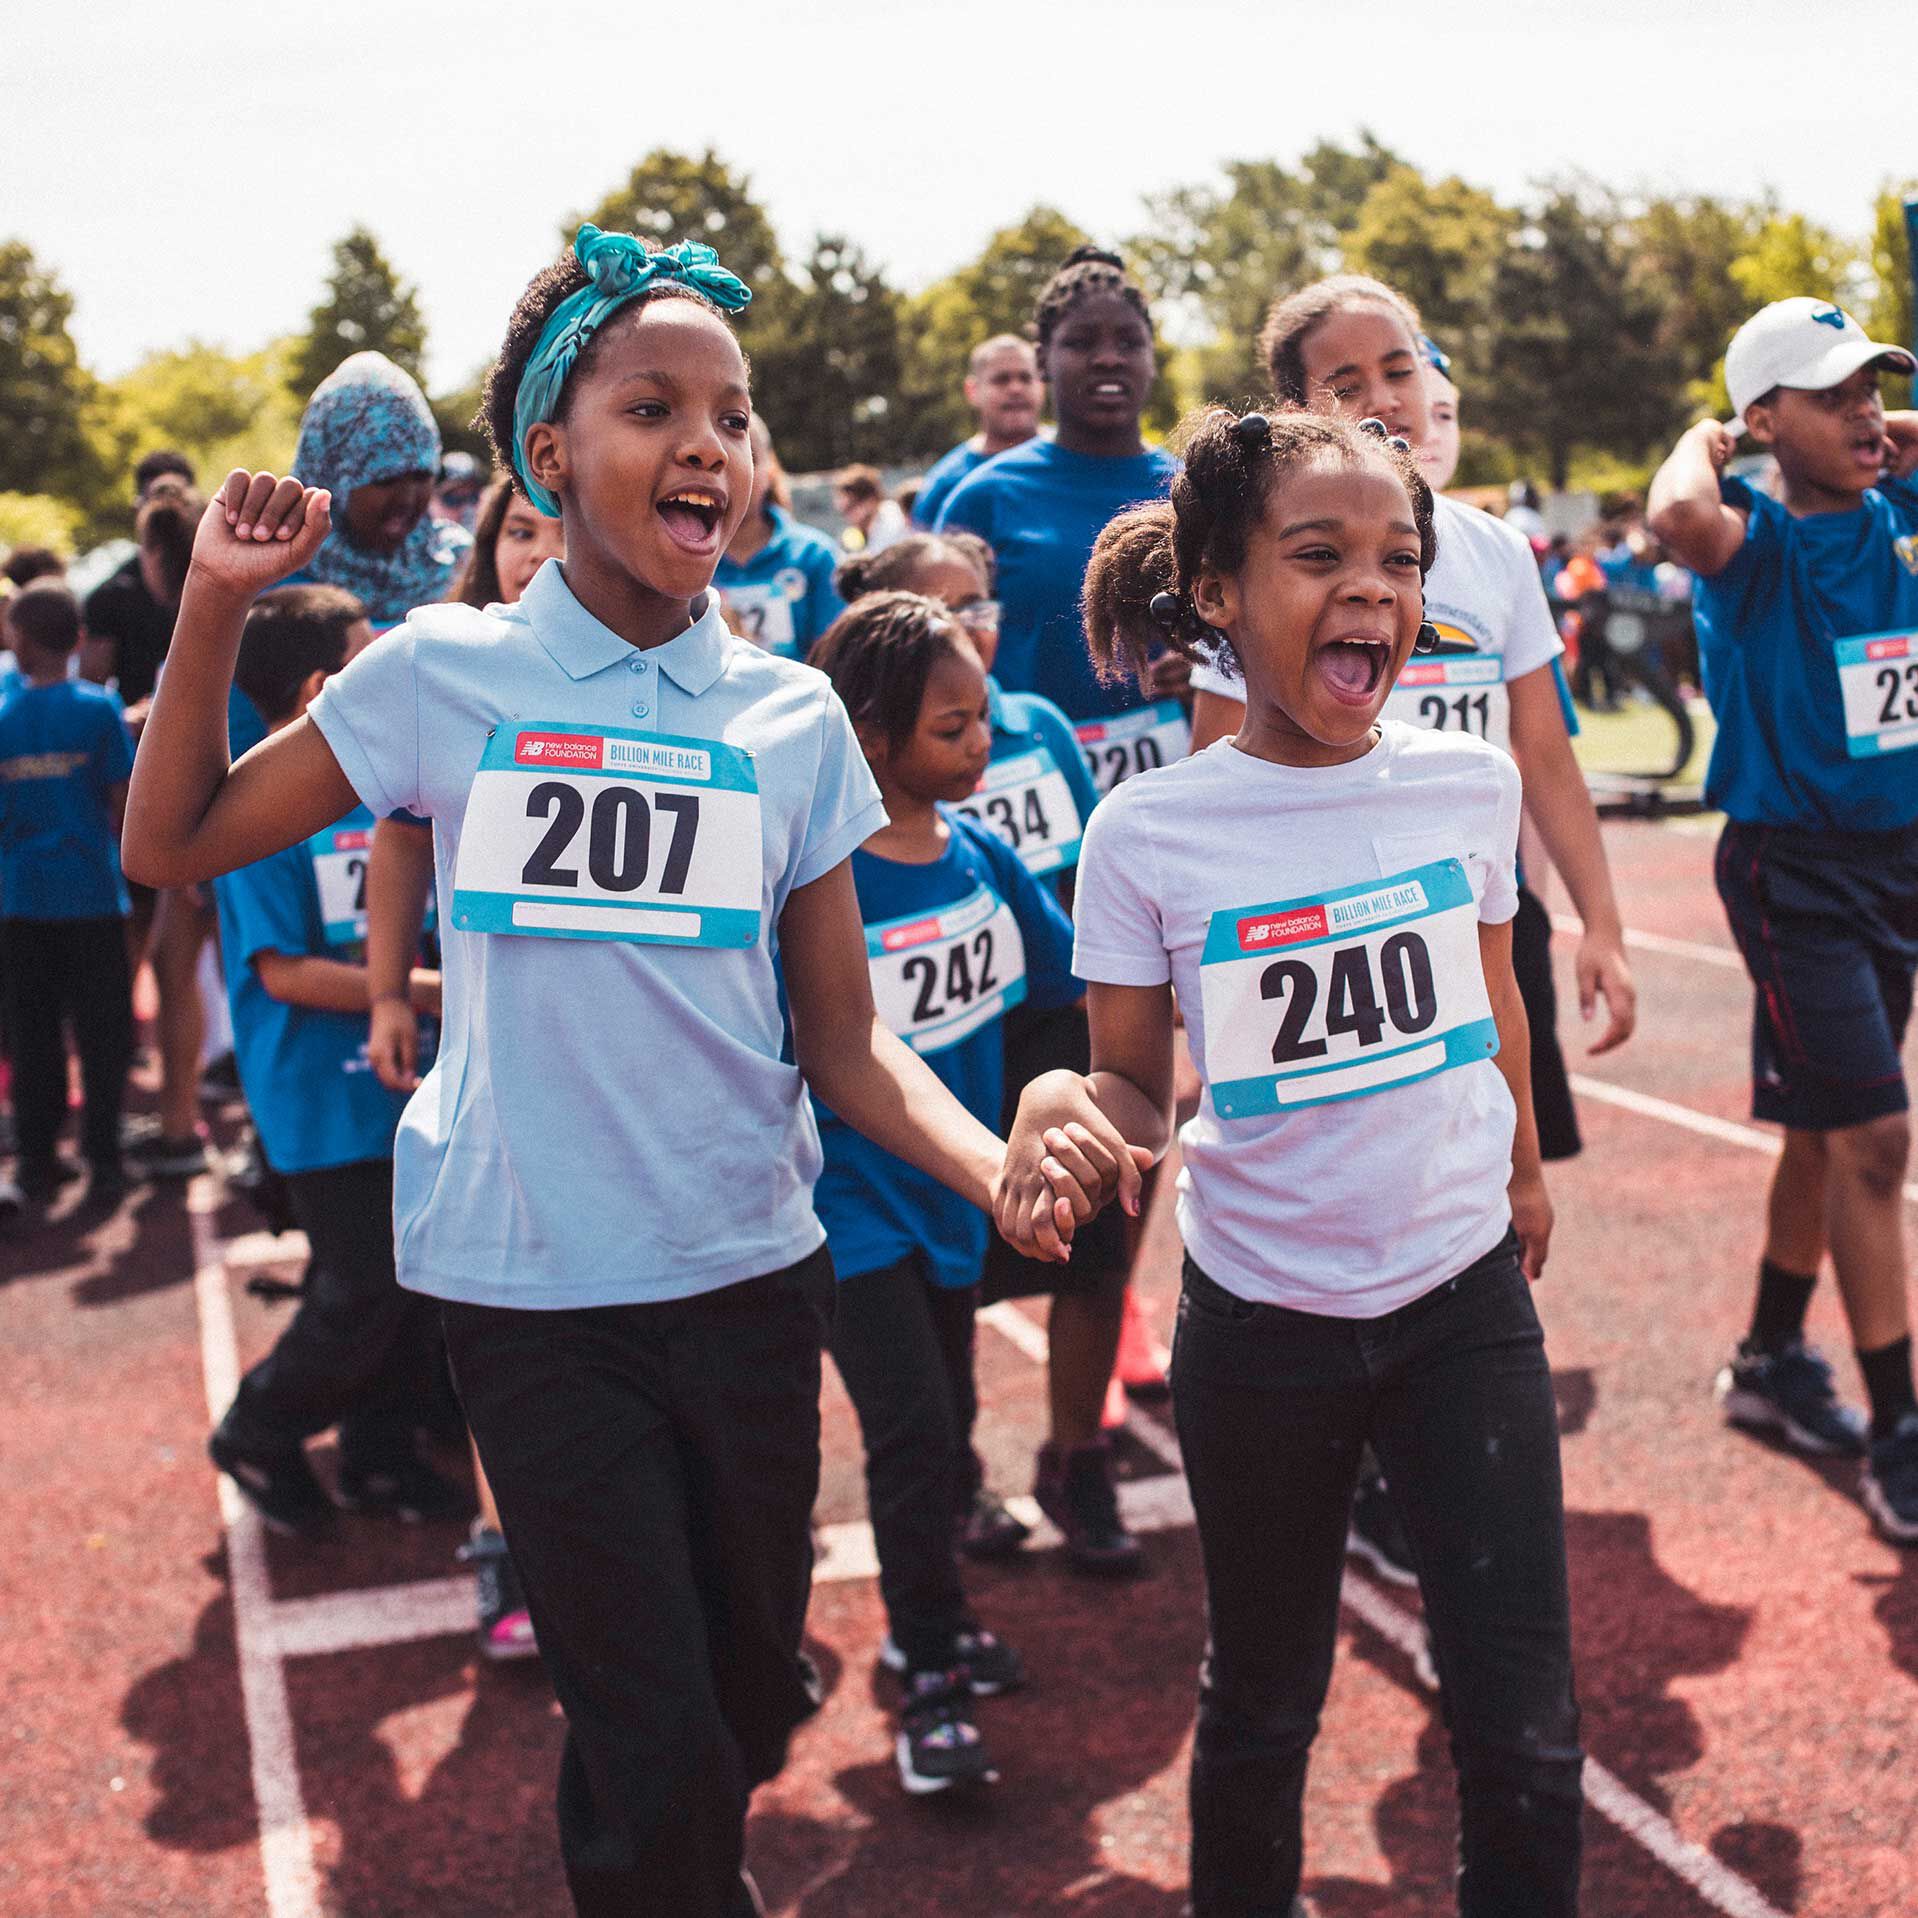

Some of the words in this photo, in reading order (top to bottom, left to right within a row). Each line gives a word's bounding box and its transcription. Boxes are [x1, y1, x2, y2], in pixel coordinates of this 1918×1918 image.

[545, 748, 597, 760] FOUNDATION
[563, 742, 597, 752] balance
[610, 744, 650, 764] BILLION
[652, 749, 674, 768] MILE
[677, 753, 704, 771] RACE
[1086, 736, 1161, 789] 20
[958, 787, 1048, 848] 34
[522, 781, 700, 894] 207
[1270, 921, 1287, 930] new
[1287, 914, 1320, 926] balance
[1332, 901, 1371, 923] BILLION
[1371, 894, 1393, 913] MILE
[1393, 887, 1420, 907] RACE
[1271, 920, 1322, 938] FOUNDATION
[903, 928, 997, 1023] 242
[1260, 931, 1437, 1064] 240
